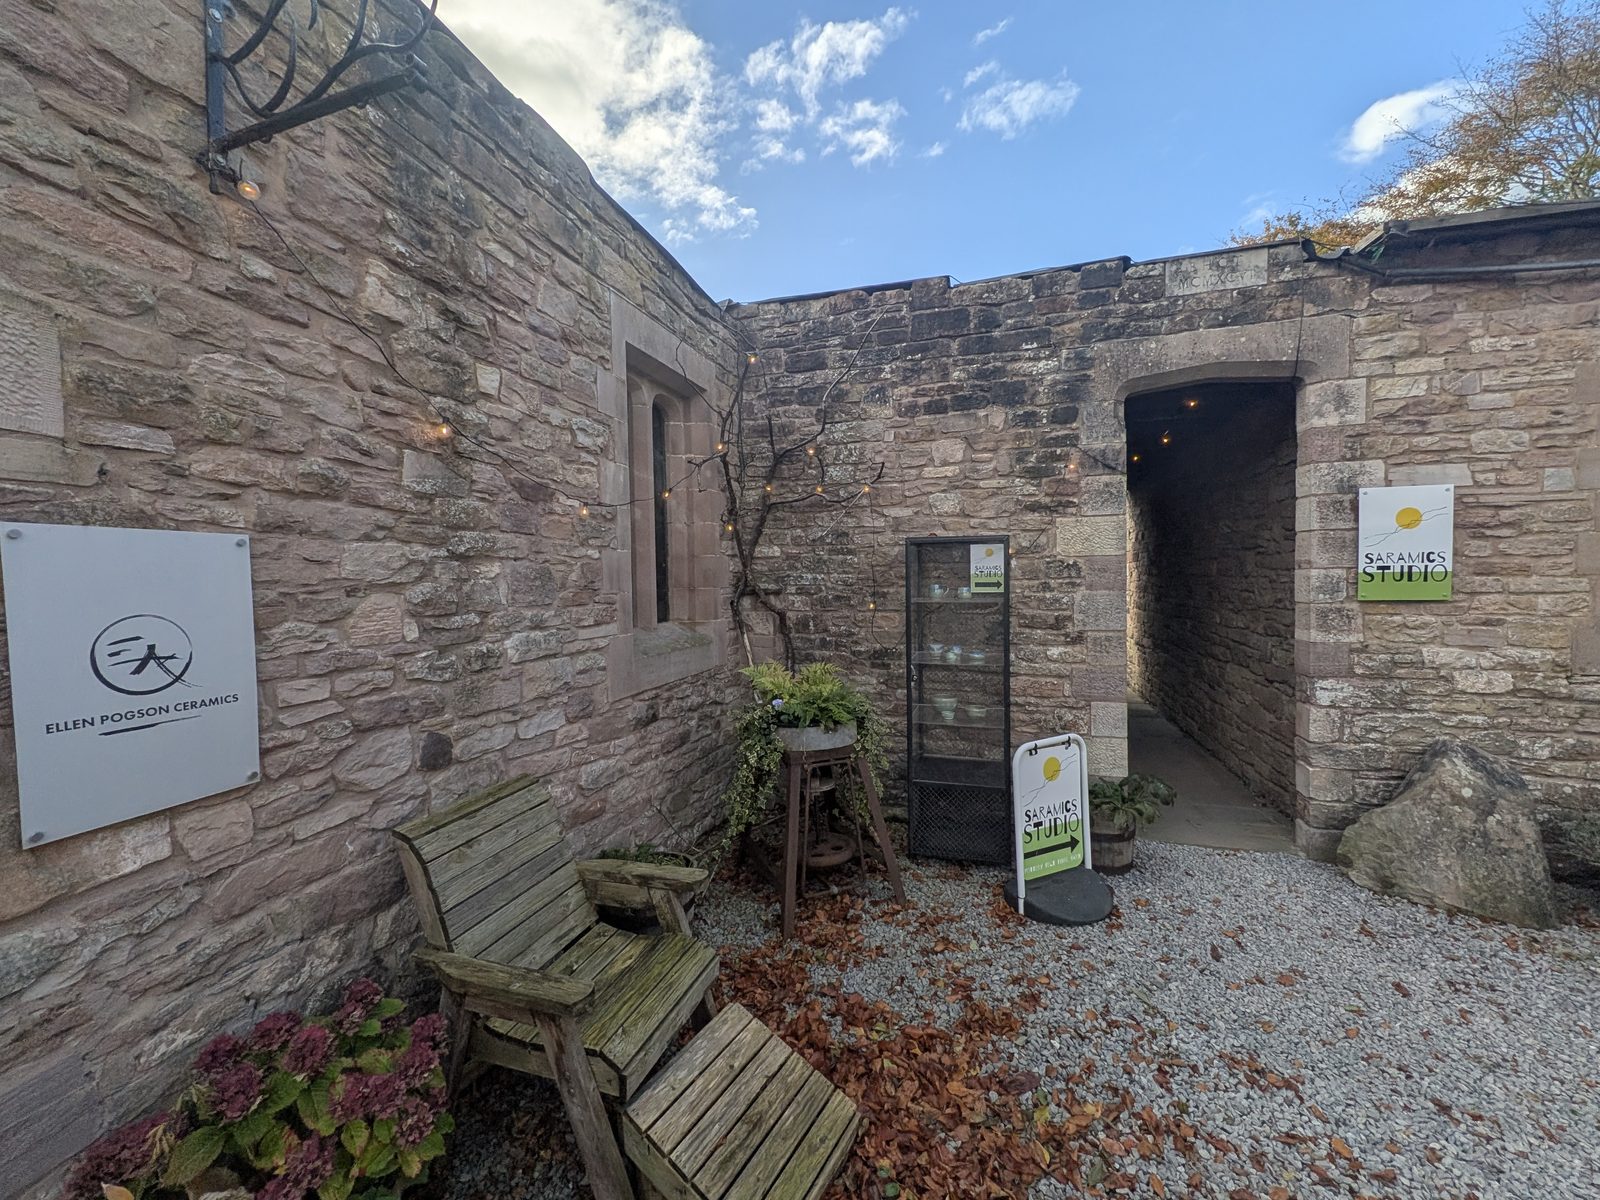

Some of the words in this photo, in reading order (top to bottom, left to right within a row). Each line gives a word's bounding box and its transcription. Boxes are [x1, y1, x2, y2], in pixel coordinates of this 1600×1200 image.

[1364, 551, 1447, 565] SARAMICS
[974, 570, 1004, 578] STUDIO
[1361, 564, 1448, 583] STUDIO
[45, 716, 95, 735] ELLEN
[99, 704, 170, 725] POGSON
[173, 693, 240, 712] CERAMICS
[1024, 798, 1078, 824] SARAMICS
[1023, 812, 1080, 845] STUDIO
